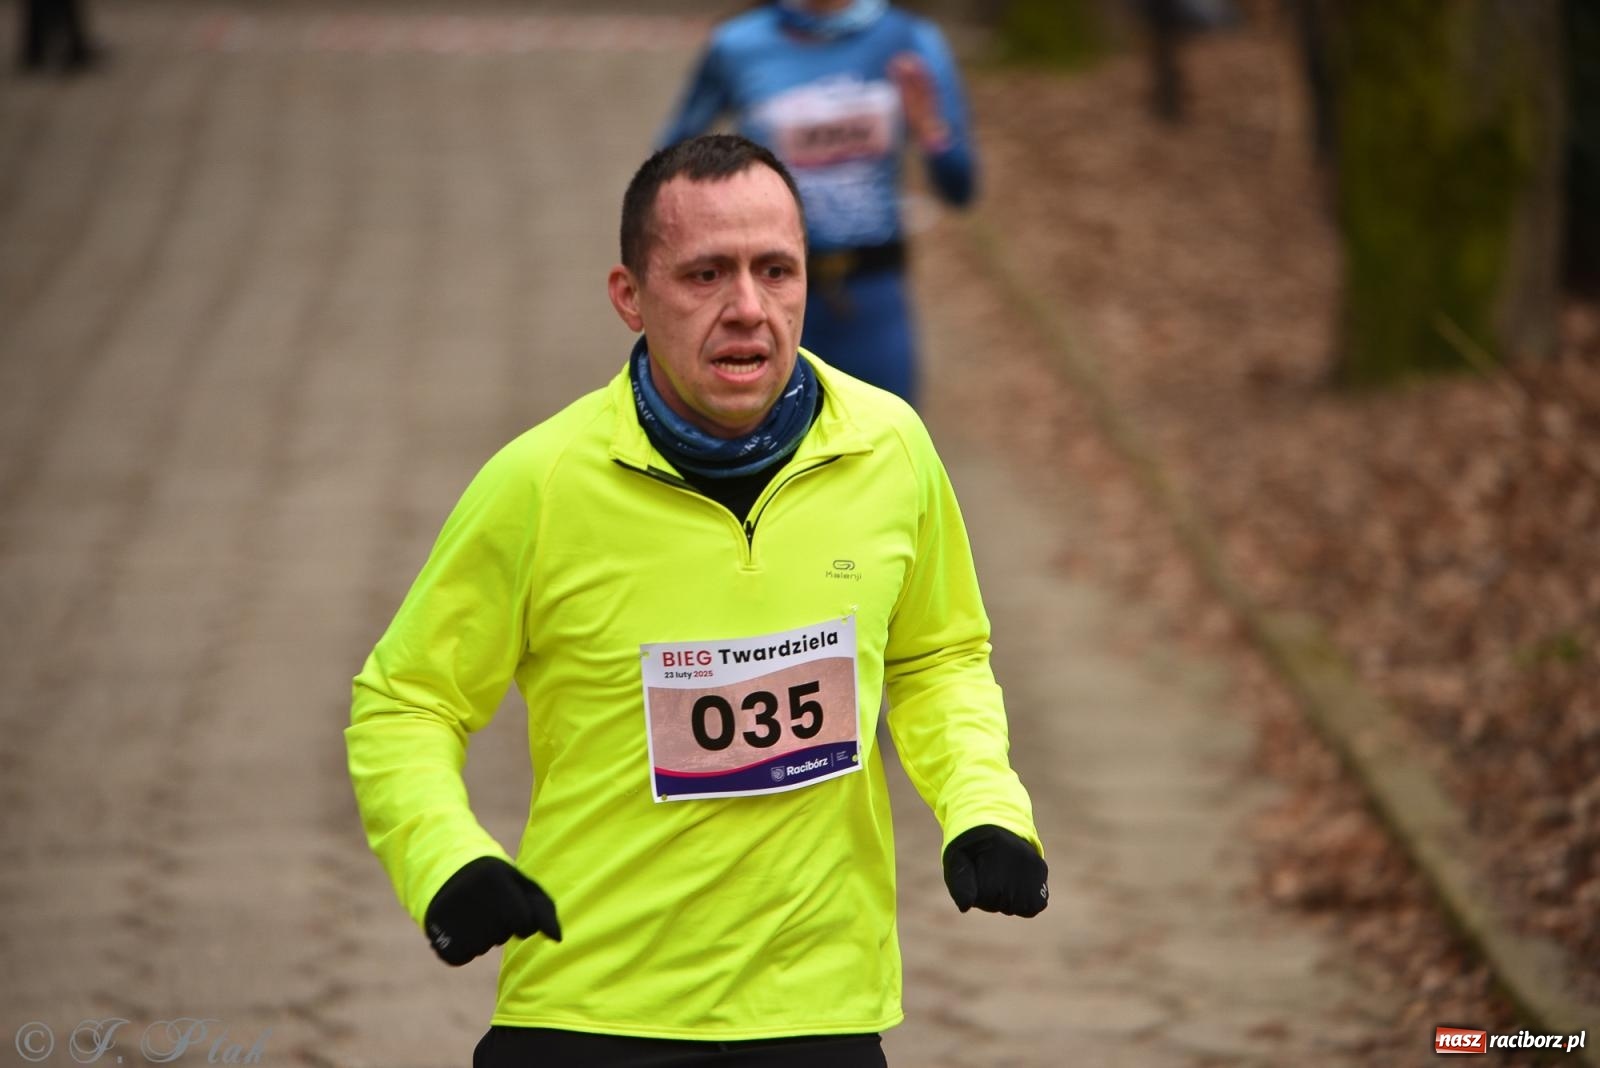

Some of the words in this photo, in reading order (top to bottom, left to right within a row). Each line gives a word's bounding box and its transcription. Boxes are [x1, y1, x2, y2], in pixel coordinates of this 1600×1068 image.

[662, 650, 713, 667] BIEG
[718, 631, 838, 664] Twardziela
[664, 671, 674, 679] 23
[675, 671, 692, 680] luty
[693, 670, 713, 678] 2025
[691, 680, 823, 751] 035
[786, 756, 828, 776] Racibórz
